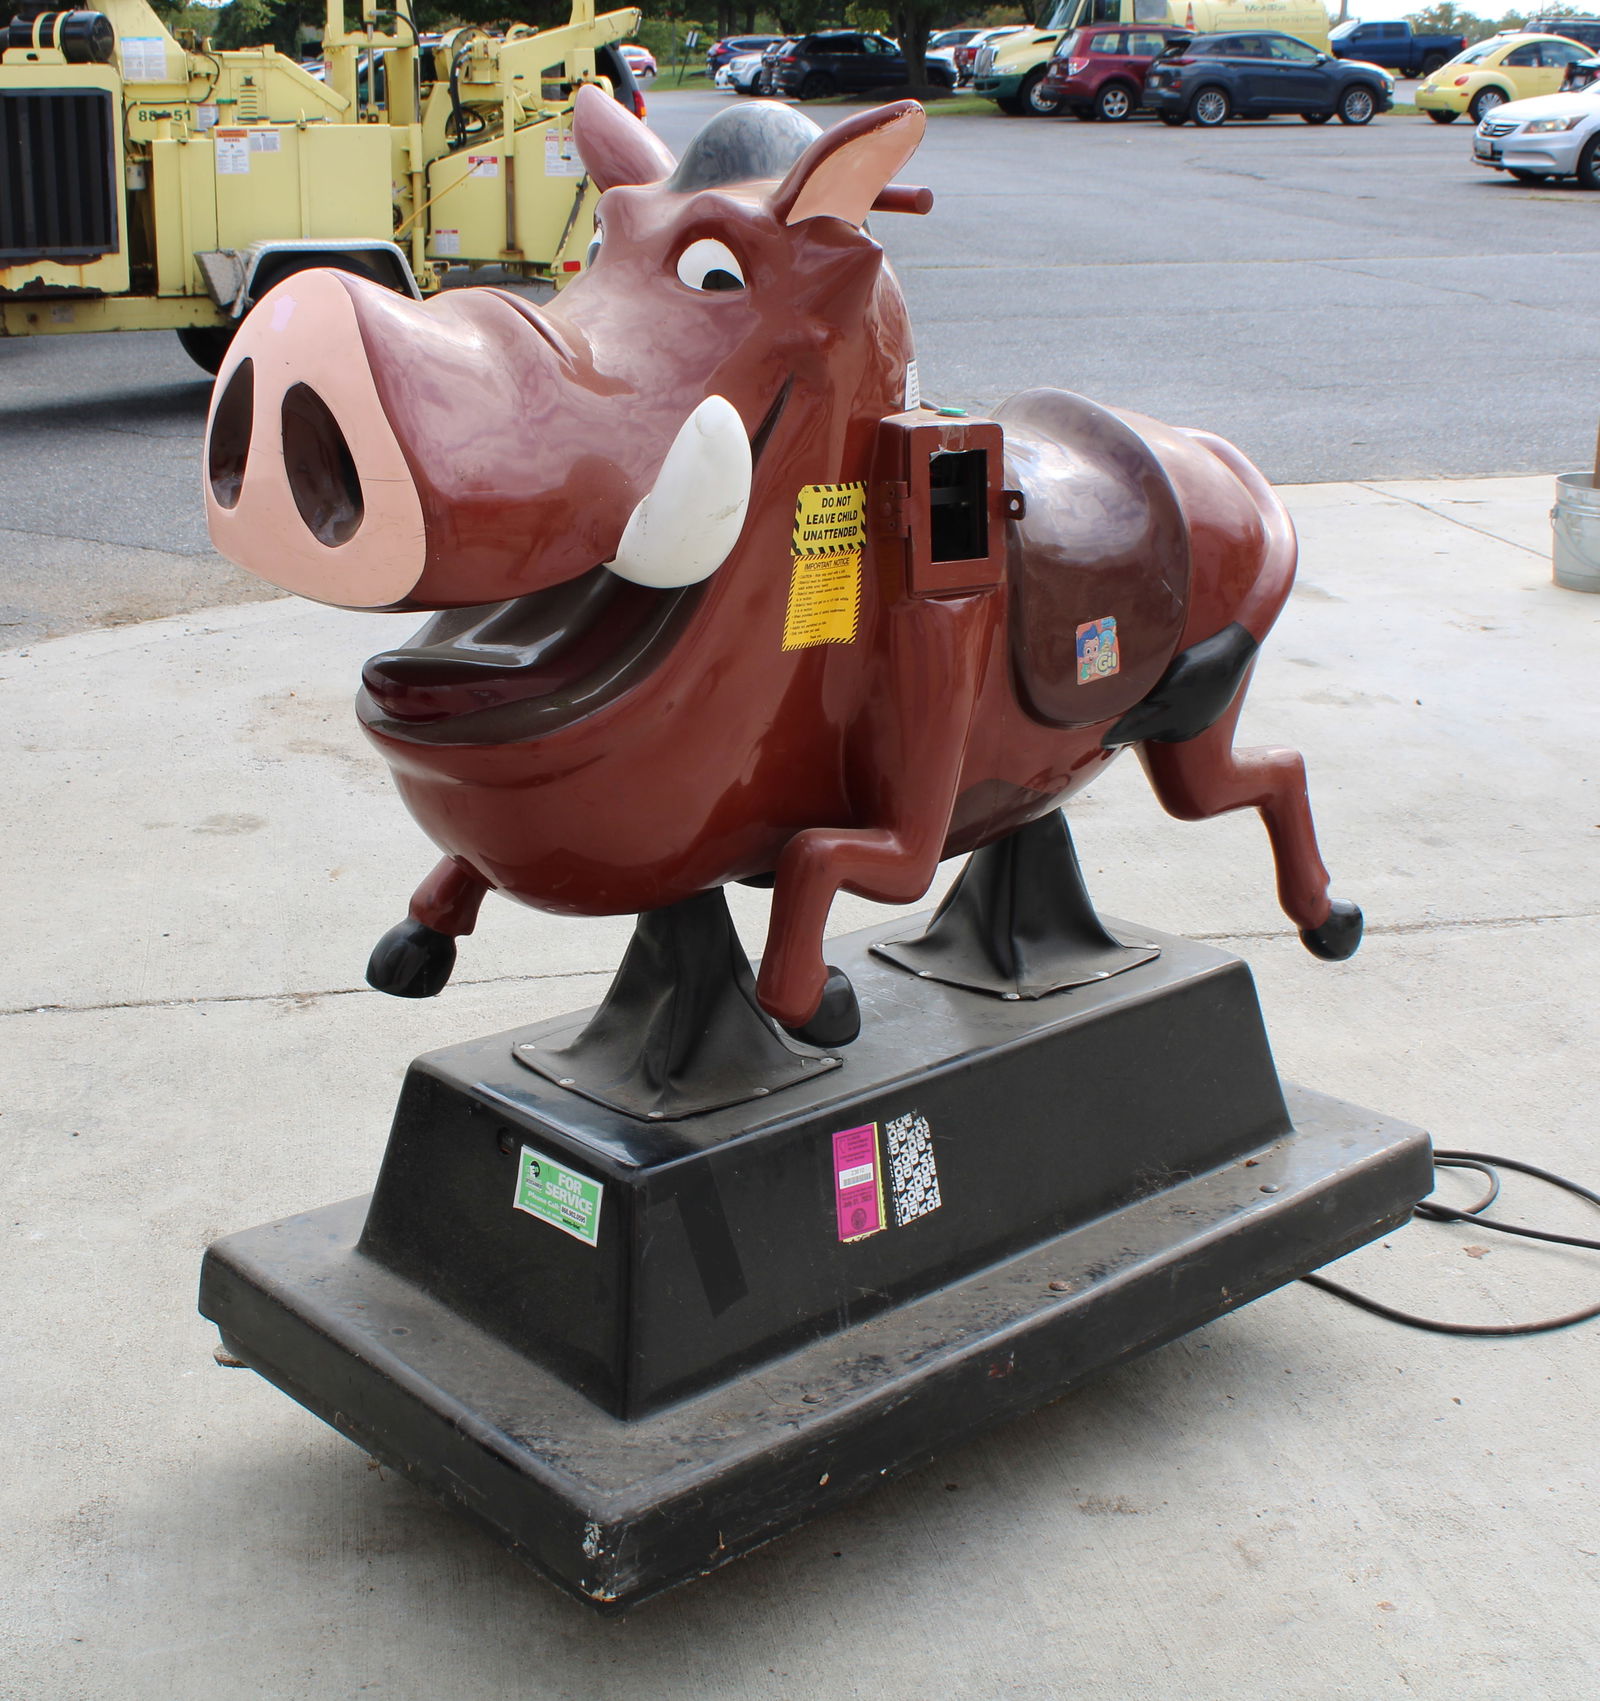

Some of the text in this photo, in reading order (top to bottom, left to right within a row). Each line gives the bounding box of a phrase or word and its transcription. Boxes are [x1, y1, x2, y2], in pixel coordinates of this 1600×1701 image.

[806, 510, 858, 525] LEAVE CHILD
[822, 496, 851, 508] DO NOT
[803, 526, 858, 541] UNATTENDED
[804, 557, 850, 570] IMPORTANT NOTICE
[886, 1121, 900, 1155] VOID
[893, 1156, 906, 1192] VOID
[907, 1128, 919, 1165] VOID
[559, 1173, 582, 1195] FOR
[899, 1142, 912, 1178] VOID
[906, 1180, 918, 1216] VOID
[912, 1165, 925, 1202] VOID
[920, 1152, 932, 1188] VOID
[545, 1182, 592, 1215] SERVICE
